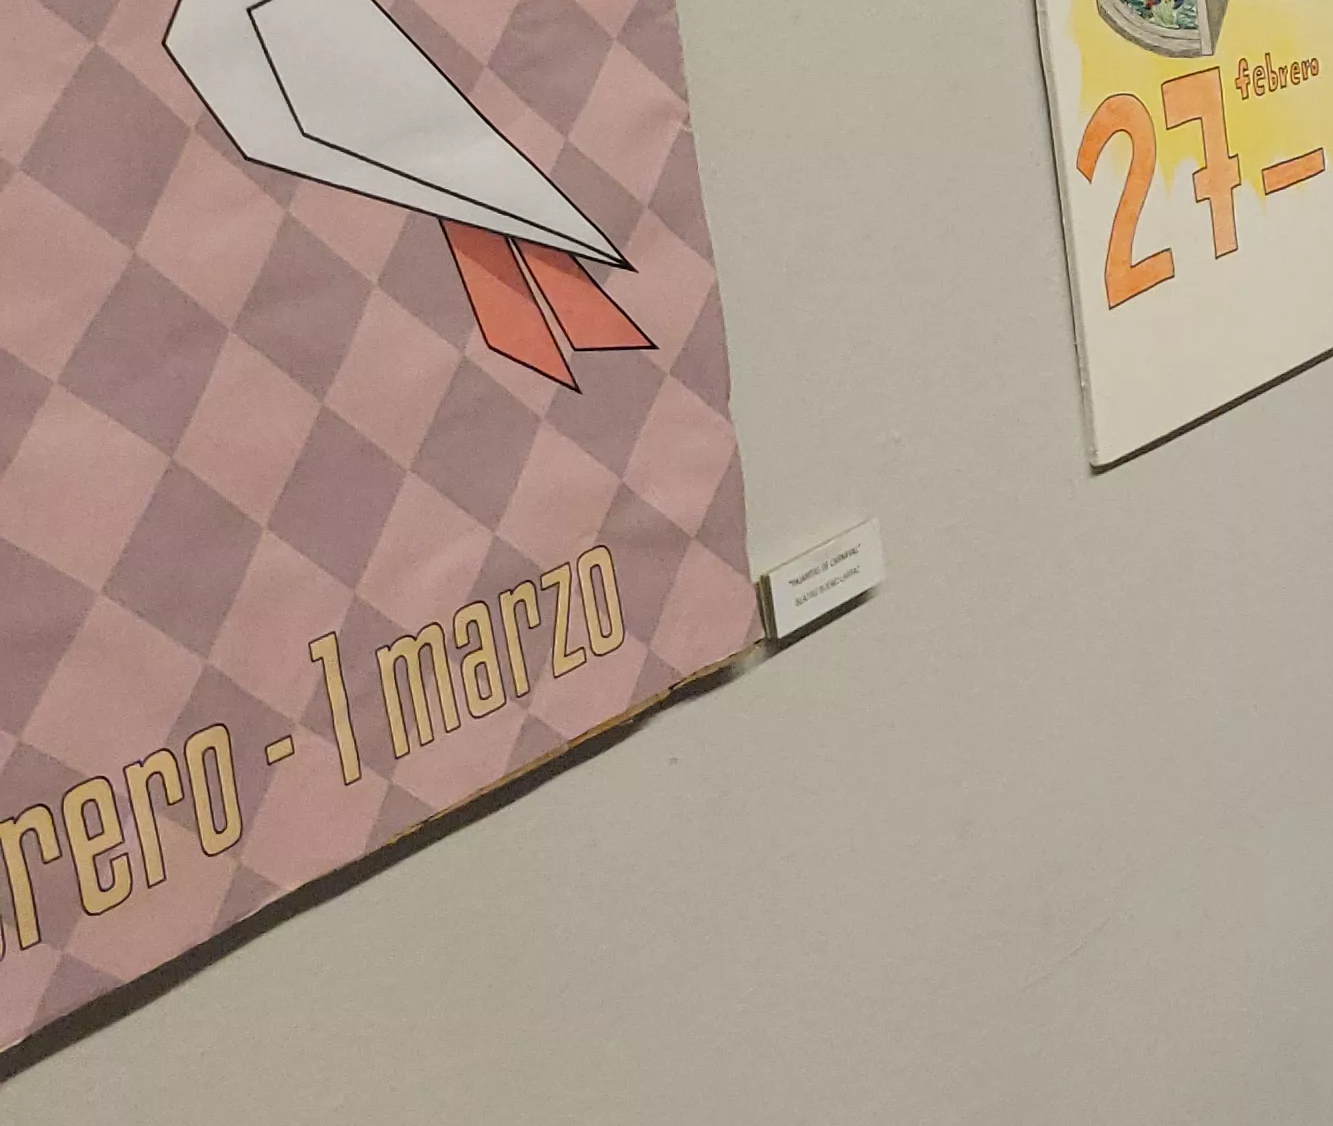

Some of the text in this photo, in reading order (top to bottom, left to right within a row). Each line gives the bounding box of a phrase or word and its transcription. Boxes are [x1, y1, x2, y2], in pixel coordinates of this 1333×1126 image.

[1076, 66, 1242, 311] 27
[1235, 53, 1320, 100] febrero
[0, 723, 243, 962] rero
[308, 631, 363, 786] 1
[375, 544, 626, 760] marzo
